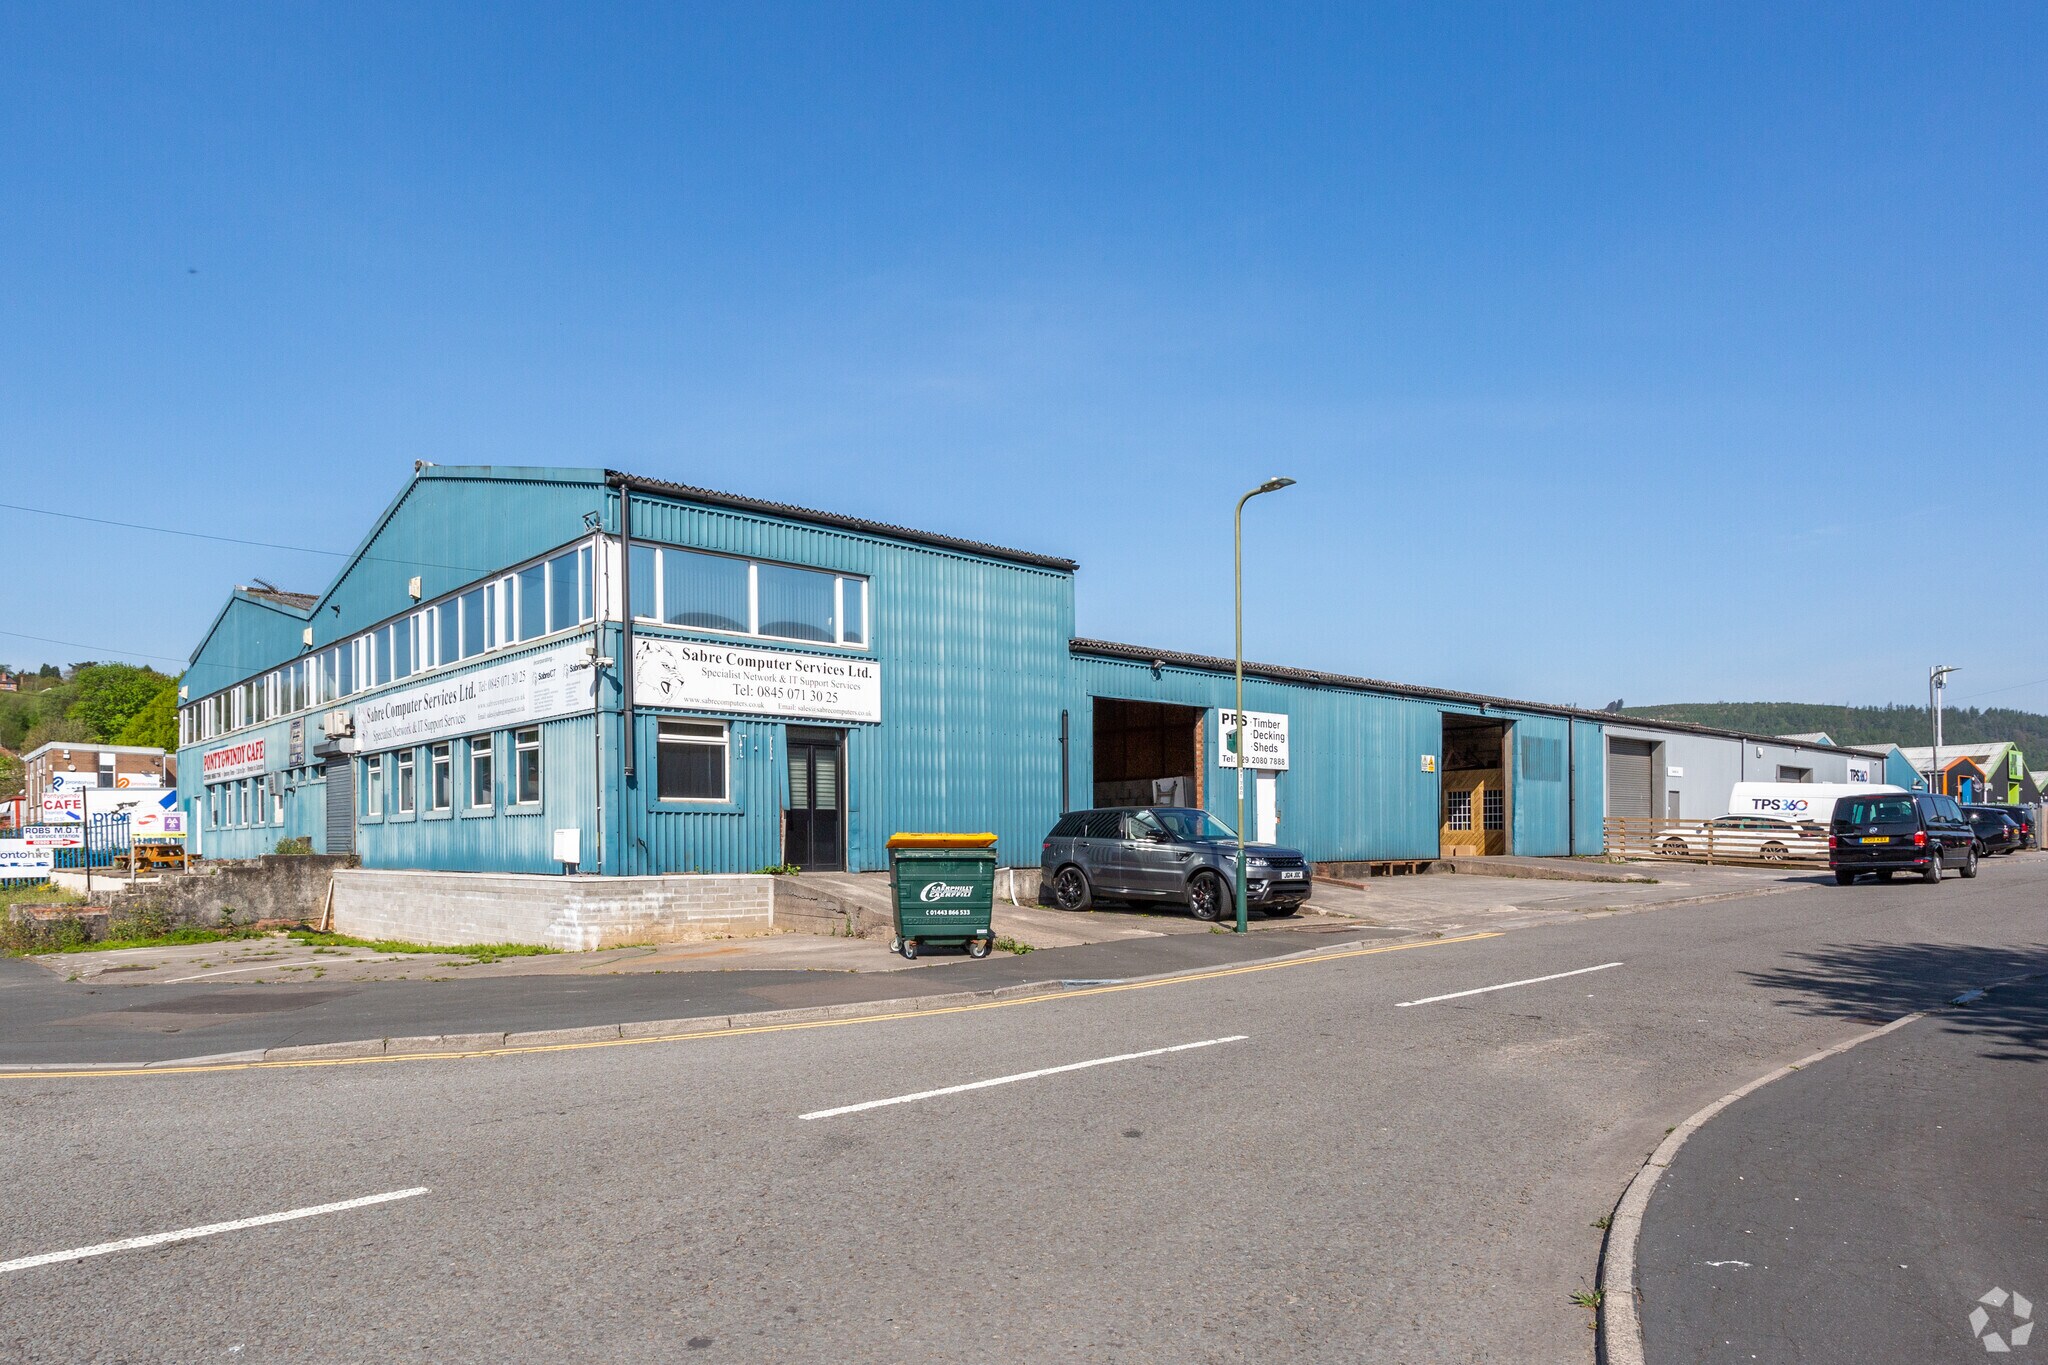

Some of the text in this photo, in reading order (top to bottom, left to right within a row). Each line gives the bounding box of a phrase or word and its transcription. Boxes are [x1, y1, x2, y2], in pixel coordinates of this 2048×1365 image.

[682, 647, 873, 679] Sabre Computer Services Ltd.
[478, 680, 487, 693] Tel:
[487, 676, 500, 690] 0845
[501, 674, 509, 687] 071
[511, 671, 518, 685] 30
[519, 670, 526, 683] 25
[701, 666, 861, 691] Specialist Network & IT Support Services
[733, 683, 838, 704] Tel: 0845 071 30 25
[366, 681, 477, 724] Sabre Computer Services Ltd.
[683, 696, 765, 710] www.sabrecomputers.co.uk
[778, 703, 797, 712] Email:
[1222, 713, 1248, 727] PRS
[1252, 717, 1280, 729] Timber
[373, 712, 467, 744] Specialist Network & IT Support Services
[1253, 729, 1285, 743] Decking
[1253, 742, 1279, 753] Sheds
[204, 745, 246, 771] PONTYGWINDY
[246, 740, 264, 762] CAFE
[1222, 754, 1236, 763] Tel:
[1251, 756, 1268, 765] 2080
[1270, 757, 1286, 766] 7888
[1850, 768, 1868, 782] TPS360
[44, 799, 82, 810] CAFE
[1752, 798, 1809, 811] TPS360
